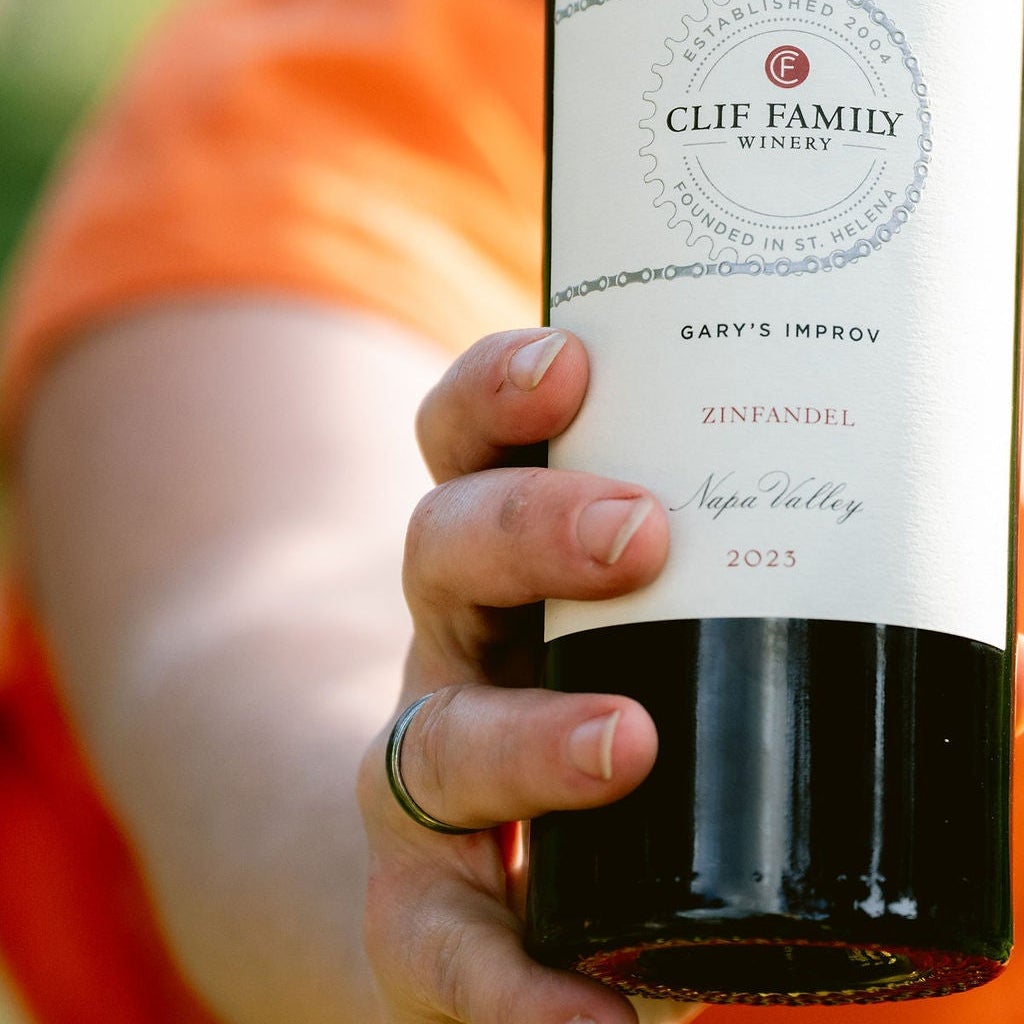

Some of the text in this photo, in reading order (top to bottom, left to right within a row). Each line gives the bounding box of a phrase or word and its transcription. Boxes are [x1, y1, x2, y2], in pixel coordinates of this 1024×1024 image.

[843, 16, 892, 65] 2004
[666, 102, 904, 137] CLIF FAMILY
[739, 135, 833, 151] WINERY
[673, 181, 897, 252] FOUNDED IN ST. HELENA
[680, 323, 880, 344] GARY'S IMPROV
[702, 406, 856, 427] ZINFANDEL
[669, 470, 865, 525] Napa Valley
[726, 549, 797, 568] 2023
